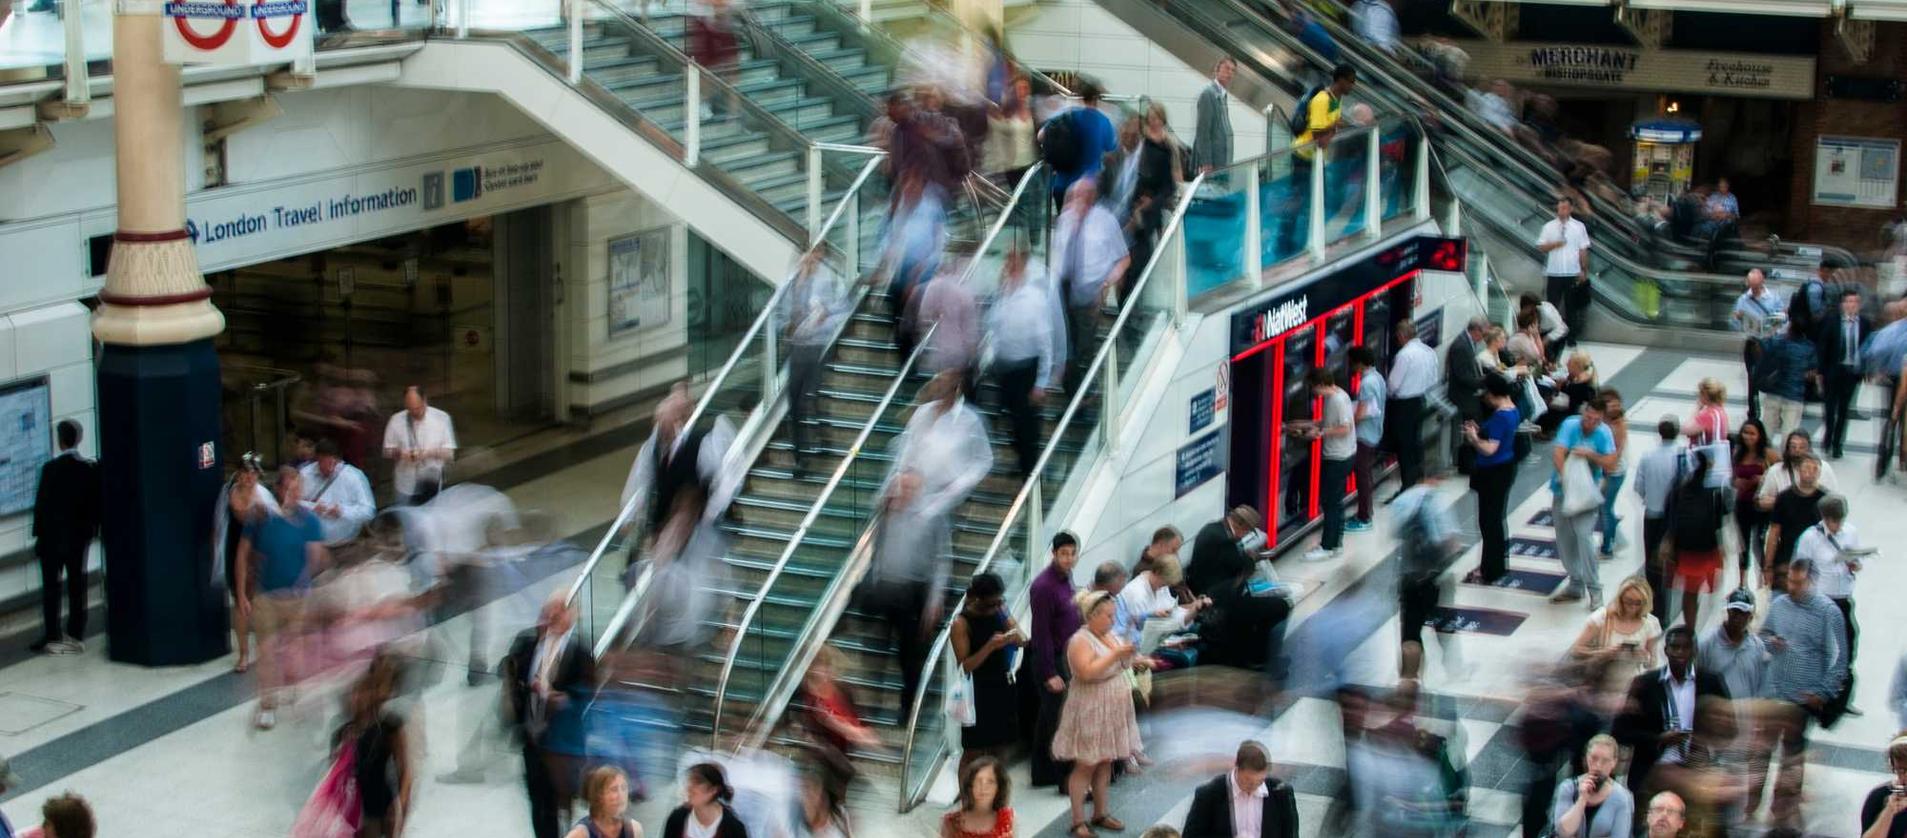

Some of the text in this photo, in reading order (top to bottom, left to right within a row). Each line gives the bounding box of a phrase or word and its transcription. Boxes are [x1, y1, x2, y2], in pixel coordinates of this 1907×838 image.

[170, 4, 240, 15] UNDERGROUND
[253, 3, 305, 14] UNDERGROUND
[1531, 47, 1639, 71] MERCHANT
[205, 186, 417, 243] London Travel Information
[1267, 294, 1308, 338] NatWest
